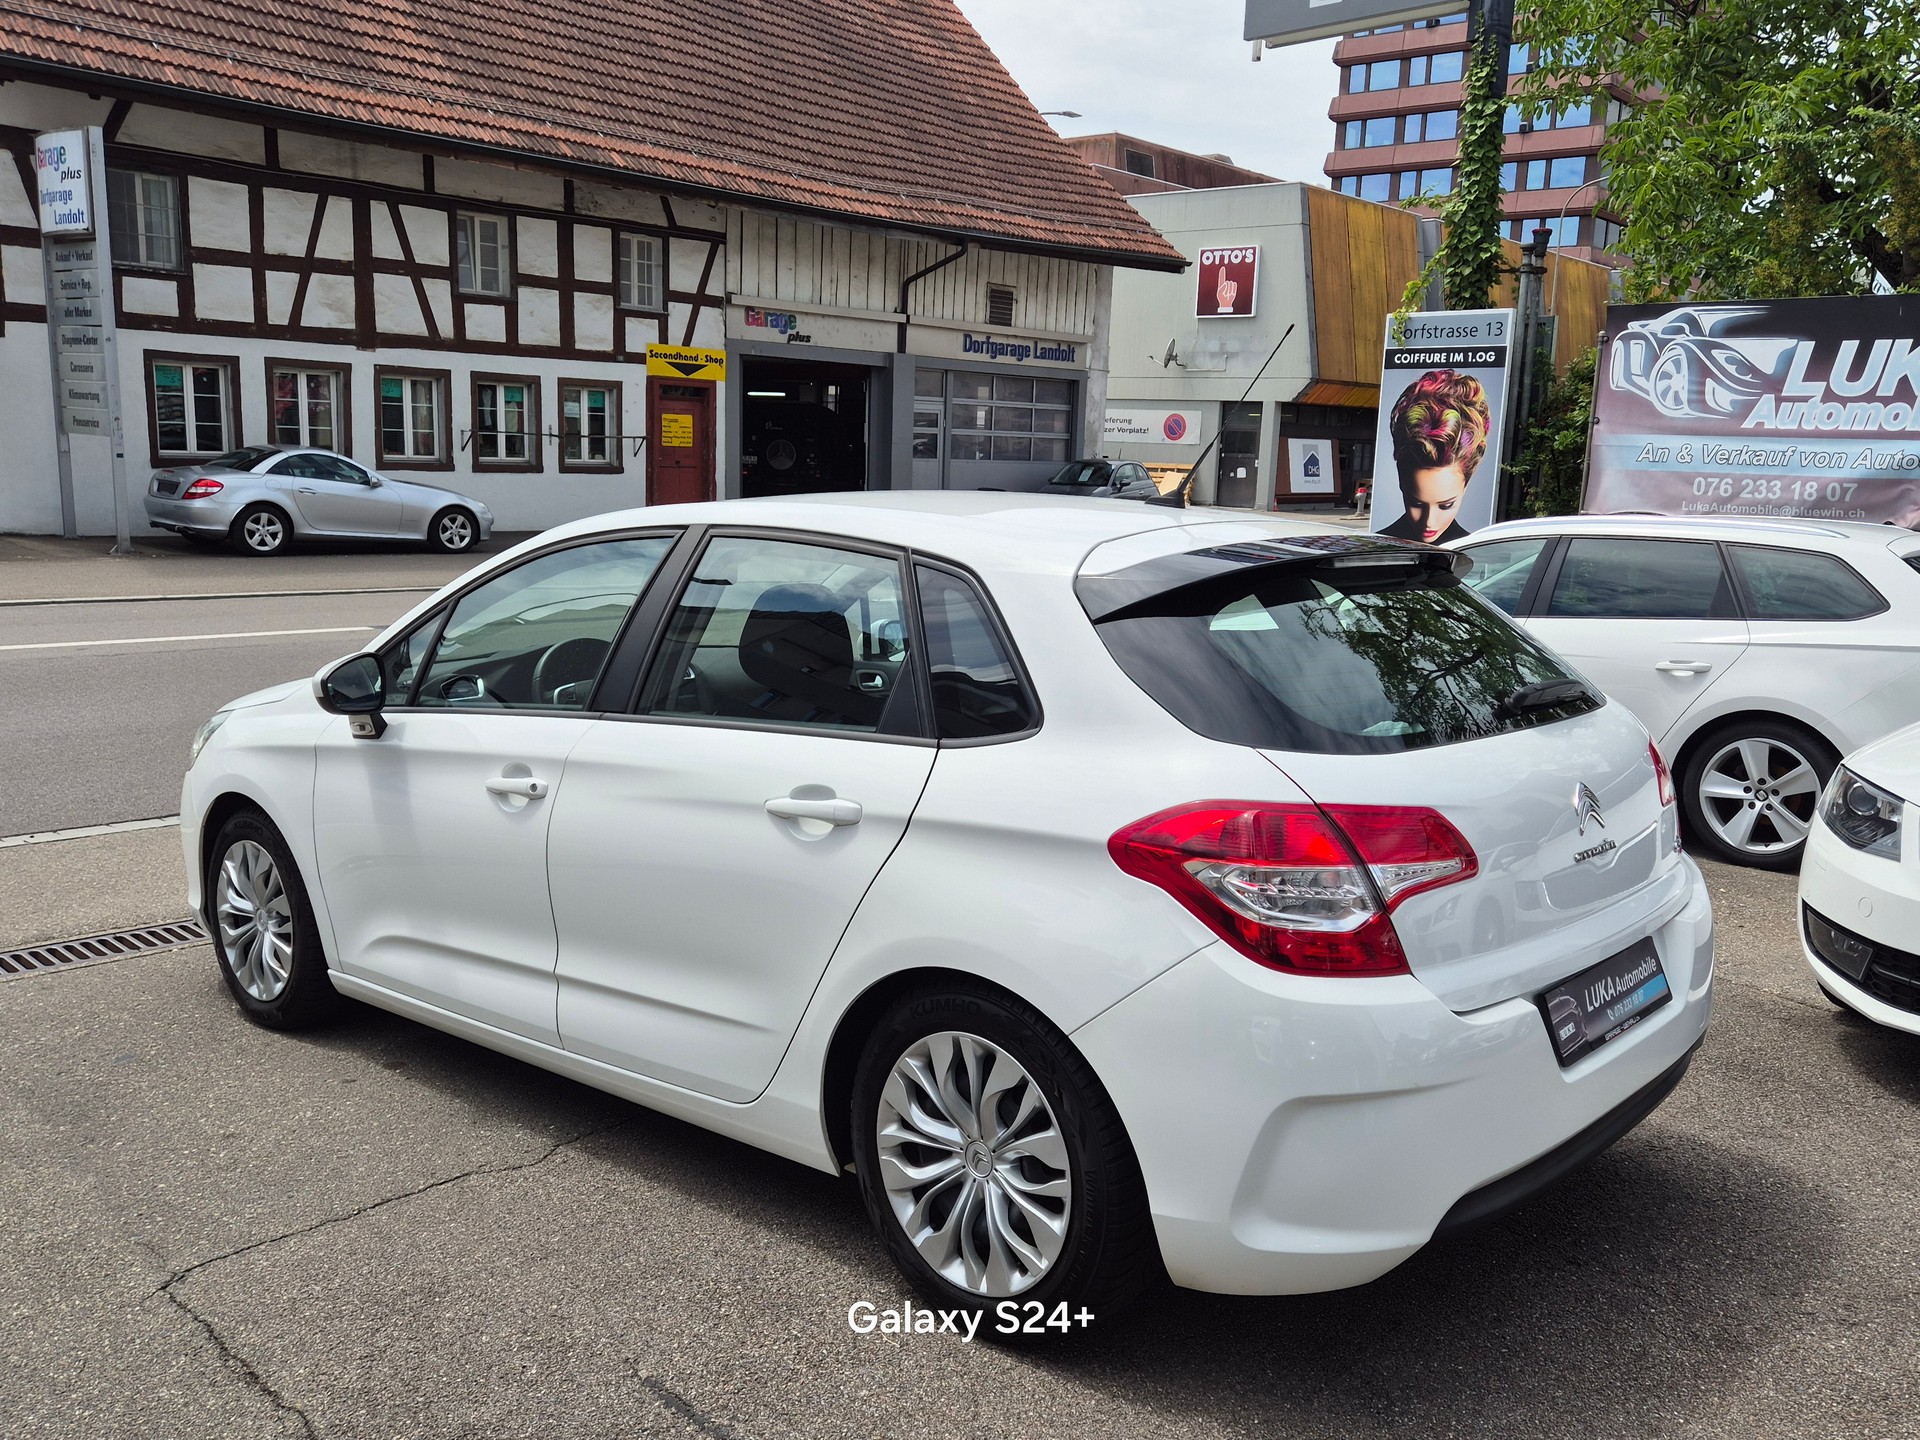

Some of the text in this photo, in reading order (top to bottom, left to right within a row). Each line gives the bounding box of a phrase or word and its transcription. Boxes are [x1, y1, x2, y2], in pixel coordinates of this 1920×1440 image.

[61, 167, 82, 183] plus
[54, 208, 85, 225] Landolt
[75, 249, 93, 261] Verkauf
[1202, 249, 1254, 265] OTTO'S
[60, 279, 77, 291] Service
[81, 278, 92, 292] Rep.
[74, 306, 92, 317] Marken
[744, 306, 797, 334] Garage
[787, 331, 812, 344] plus
[1392, 321, 1504, 341] orfstrasse 13
[963, 333, 1076, 363] Dorfgarage Landolt
[649, 350, 699, 363] Secondhand
[705, 354, 725, 367] Shop
[1394, 351, 1496, 364] COIFFURE IM 1.OG
[1117, 426, 1149, 434] Vorplatz!
[1636, 443, 1920, 471] An & Verkauf von Auto
[1308, 465, 1320, 475] DHG
[1692, 476, 1858, 502] 076 233 18 07
[1682, 500, 1866, 519] LukaAutomobile@bluewin.ch
[1584, 956, 1657, 1013] LUKA Automobile
[909, 998, 983, 1020] KUMHO
